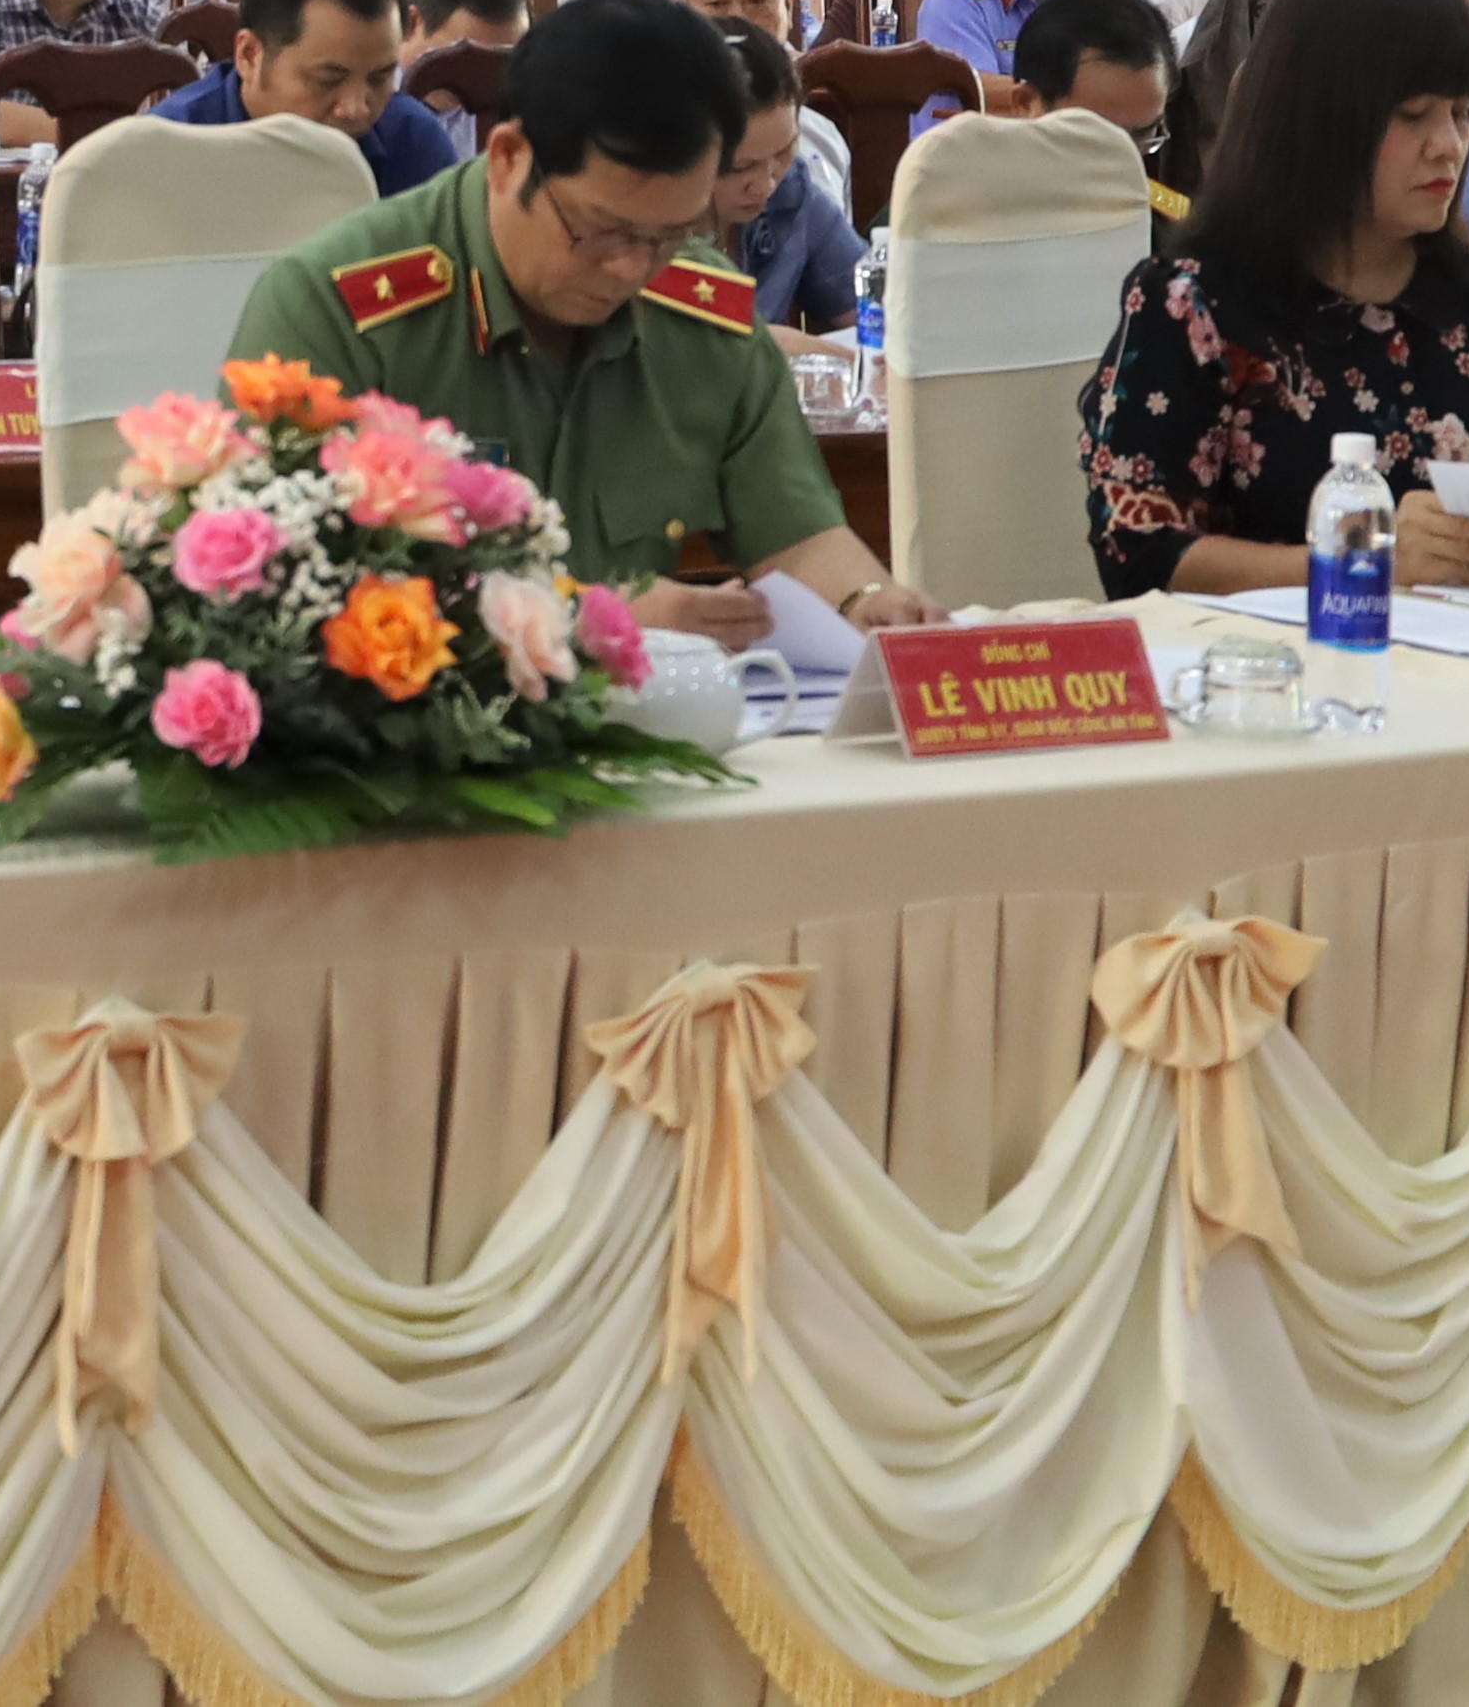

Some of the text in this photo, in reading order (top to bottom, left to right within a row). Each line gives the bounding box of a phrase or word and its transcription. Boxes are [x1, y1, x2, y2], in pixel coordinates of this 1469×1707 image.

[7, 412, 41, 436] TUY
[918, 670, 1128, 718] LÊ VINH QUY
